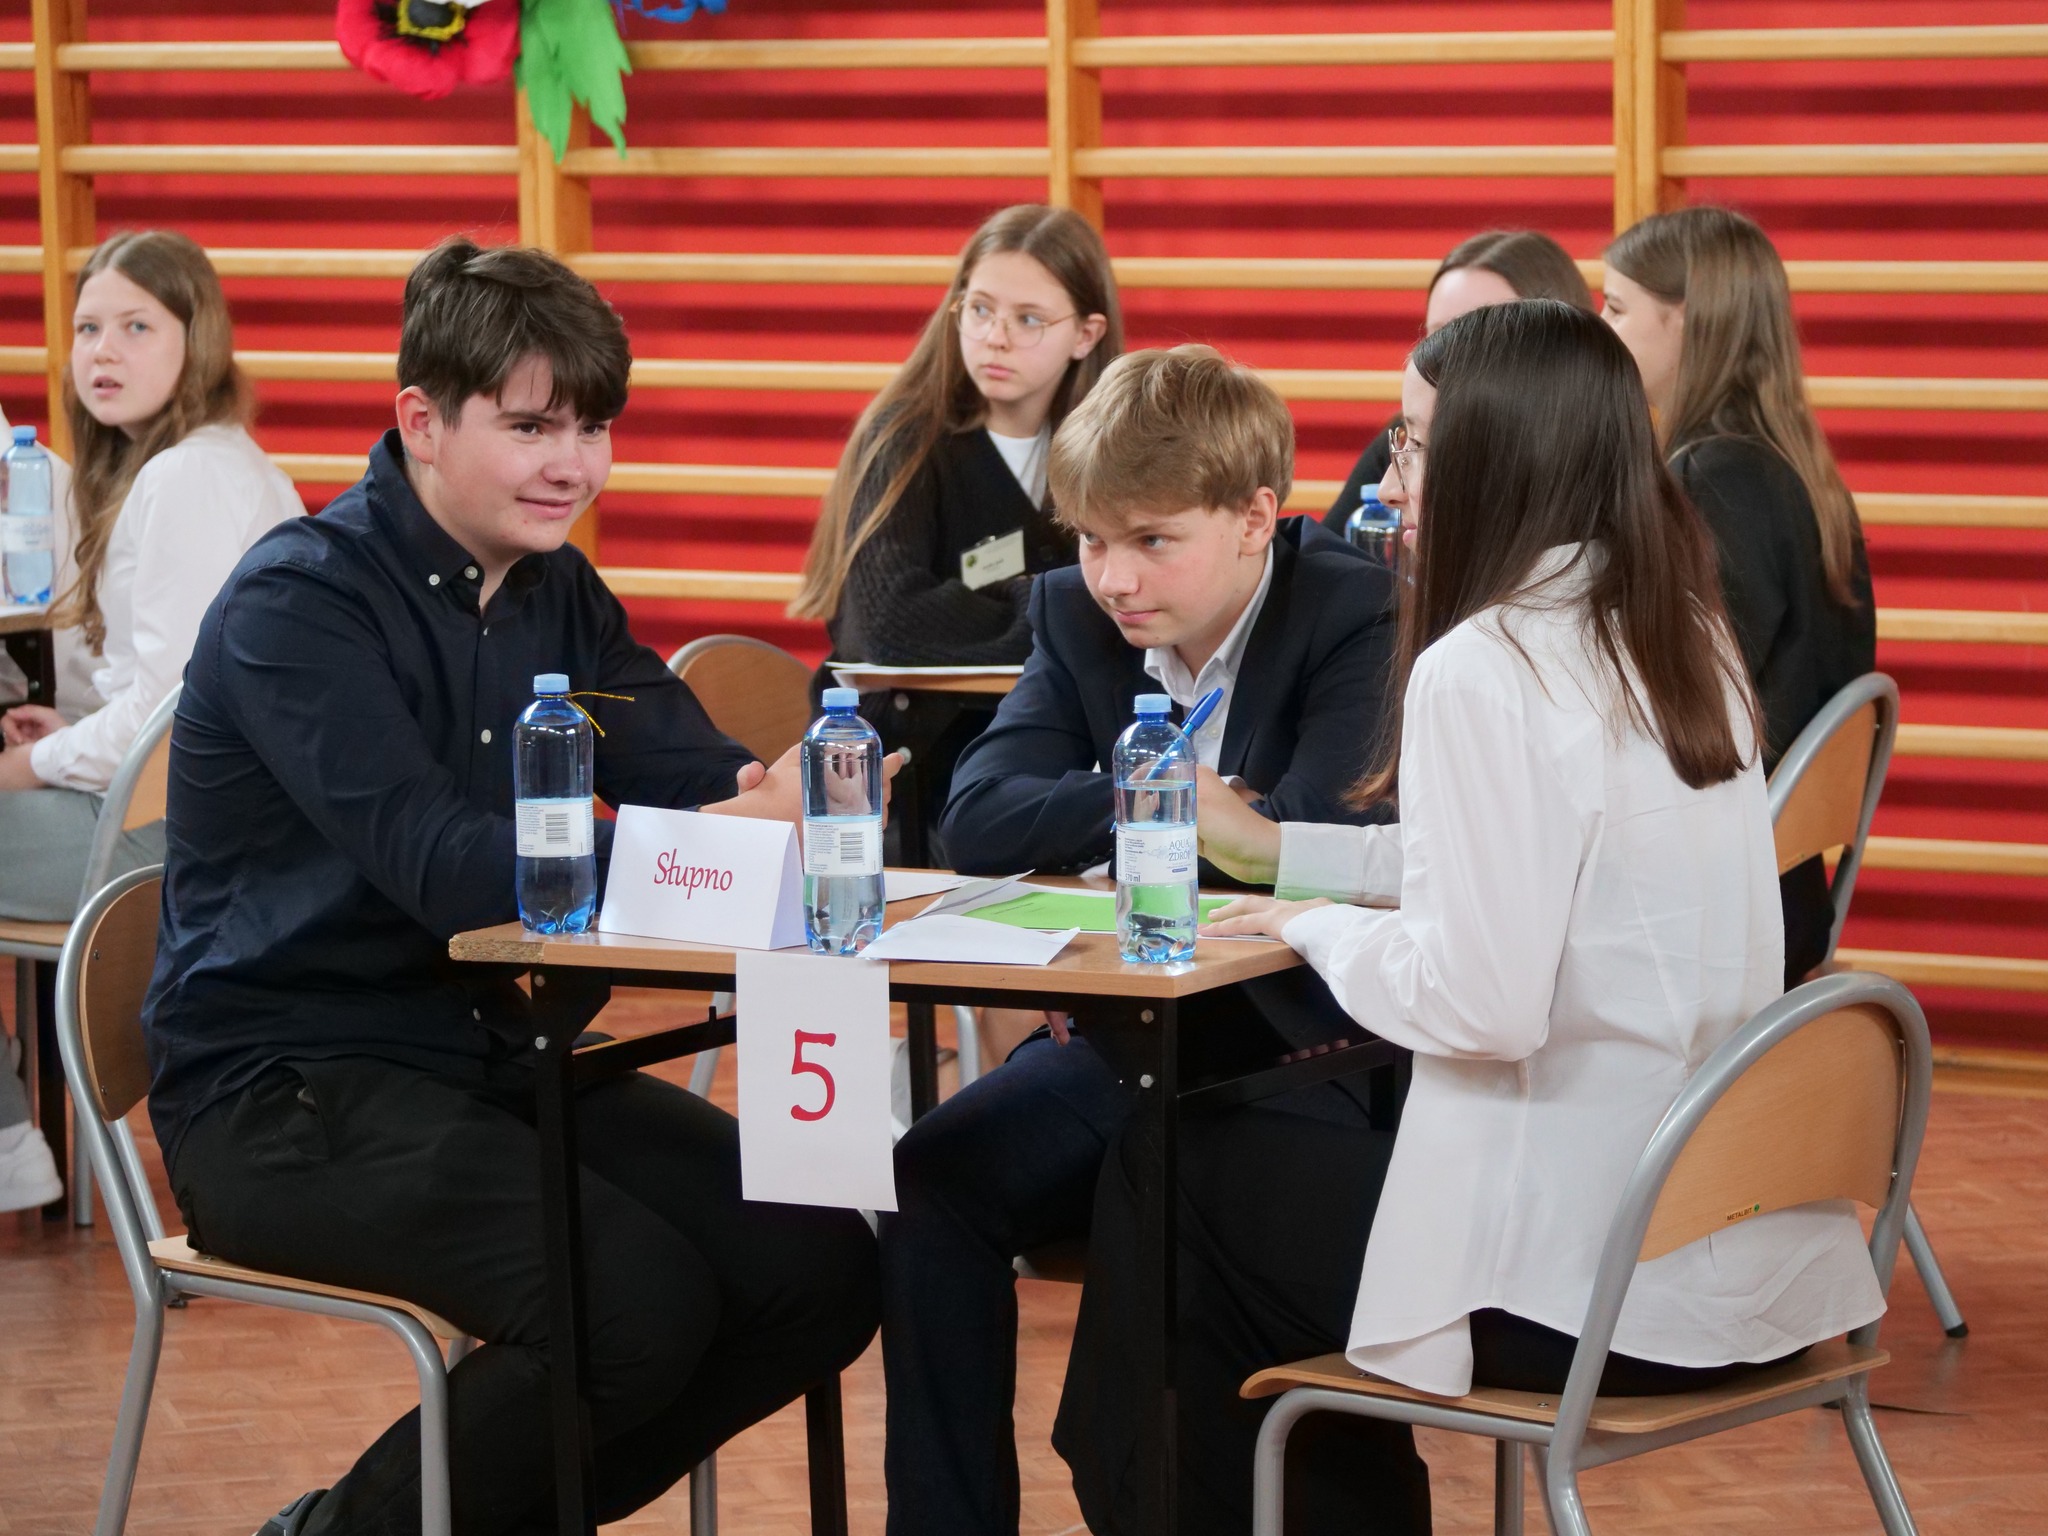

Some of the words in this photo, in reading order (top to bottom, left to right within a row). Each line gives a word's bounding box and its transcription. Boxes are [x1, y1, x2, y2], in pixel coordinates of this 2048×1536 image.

[1168, 839, 1191, 851] AQUA
[653, 848, 733, 900] Słupno
[1133, 874, 1141, 883] ml
[790, 1029, 837, 1122] 5
